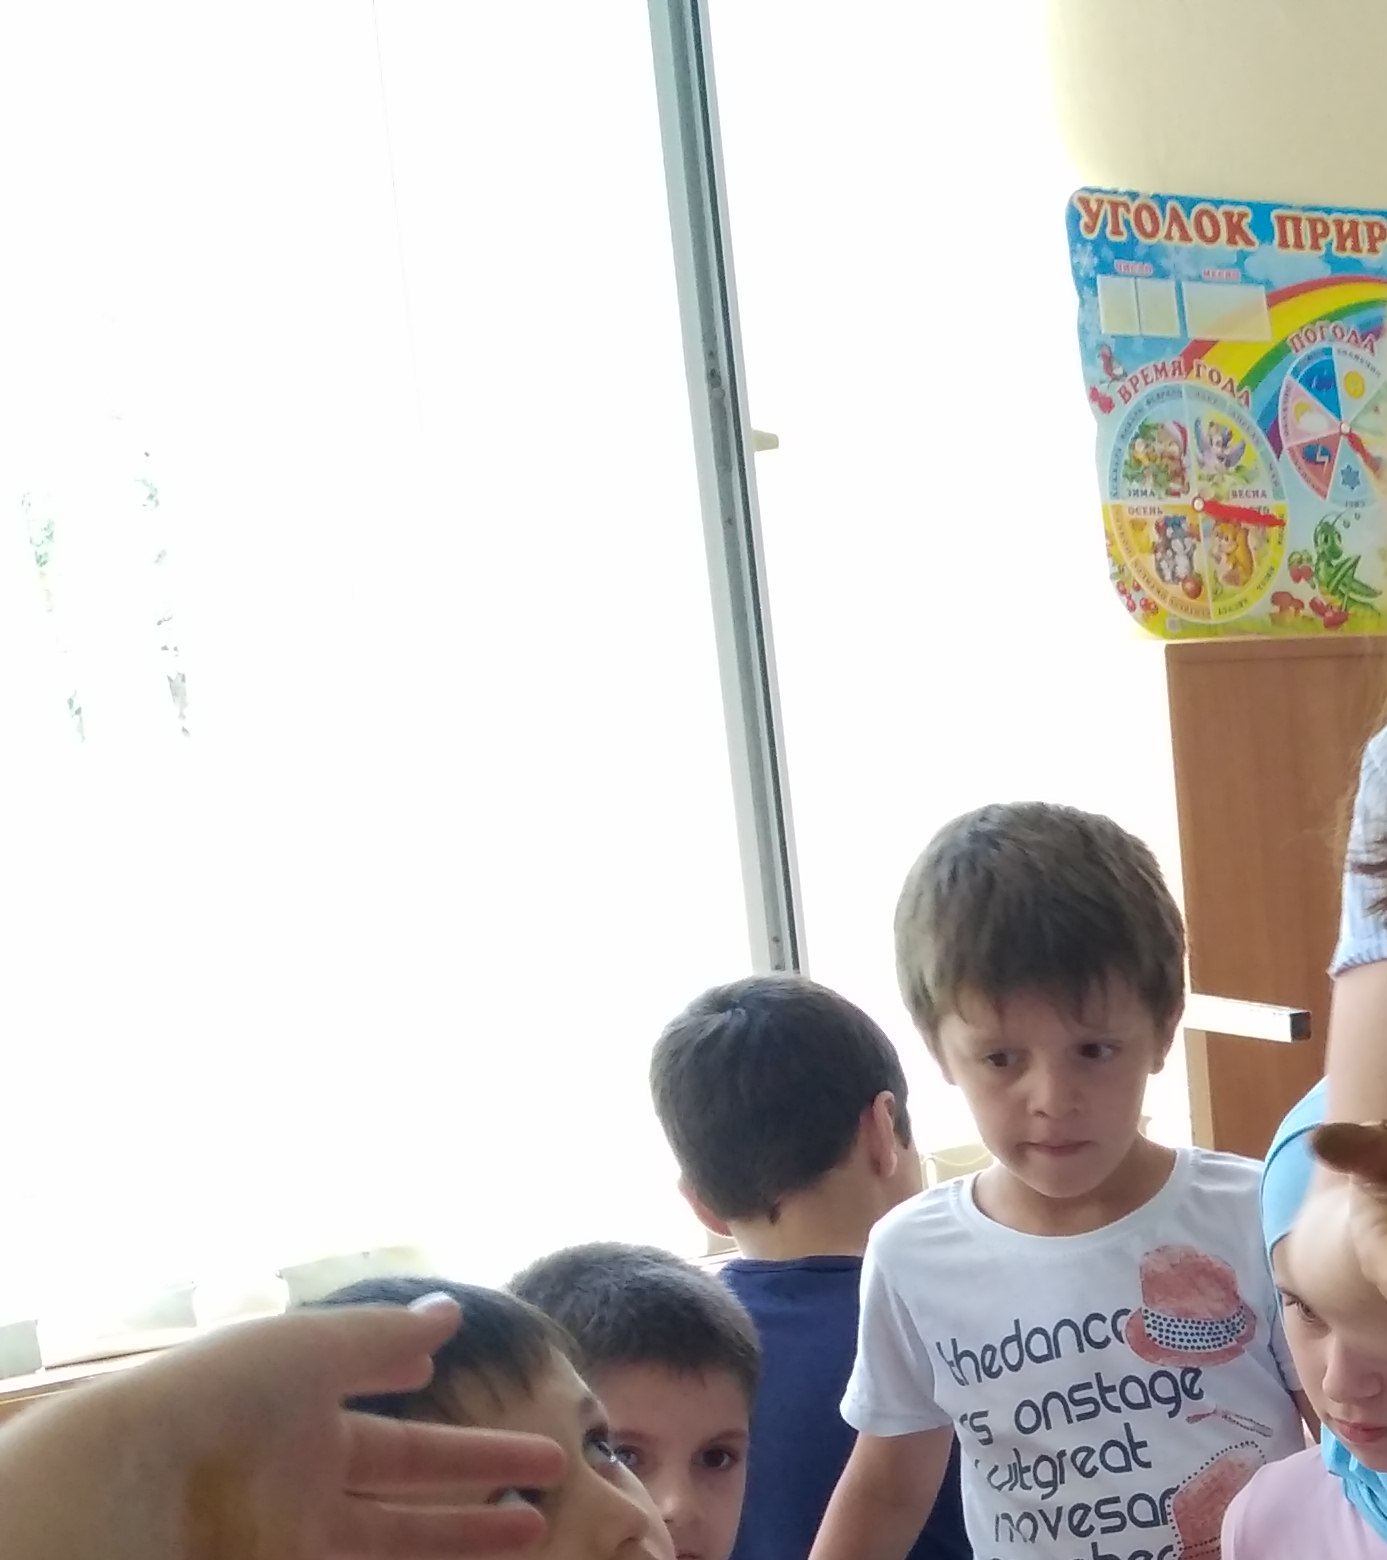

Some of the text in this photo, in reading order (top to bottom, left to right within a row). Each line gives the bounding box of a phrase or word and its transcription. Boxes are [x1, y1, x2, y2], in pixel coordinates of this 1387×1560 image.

[1077, 195, 1256, 248] УГОЛОК
[1288, 322, 1377, 356] ПОГОДА
[1117, 360, 1250, 408] ВРЕМЯ ГОДА
[1231, 488, 1268, 499] ВЕСНА
[1013, 1367, 1205, 1435] onstage
